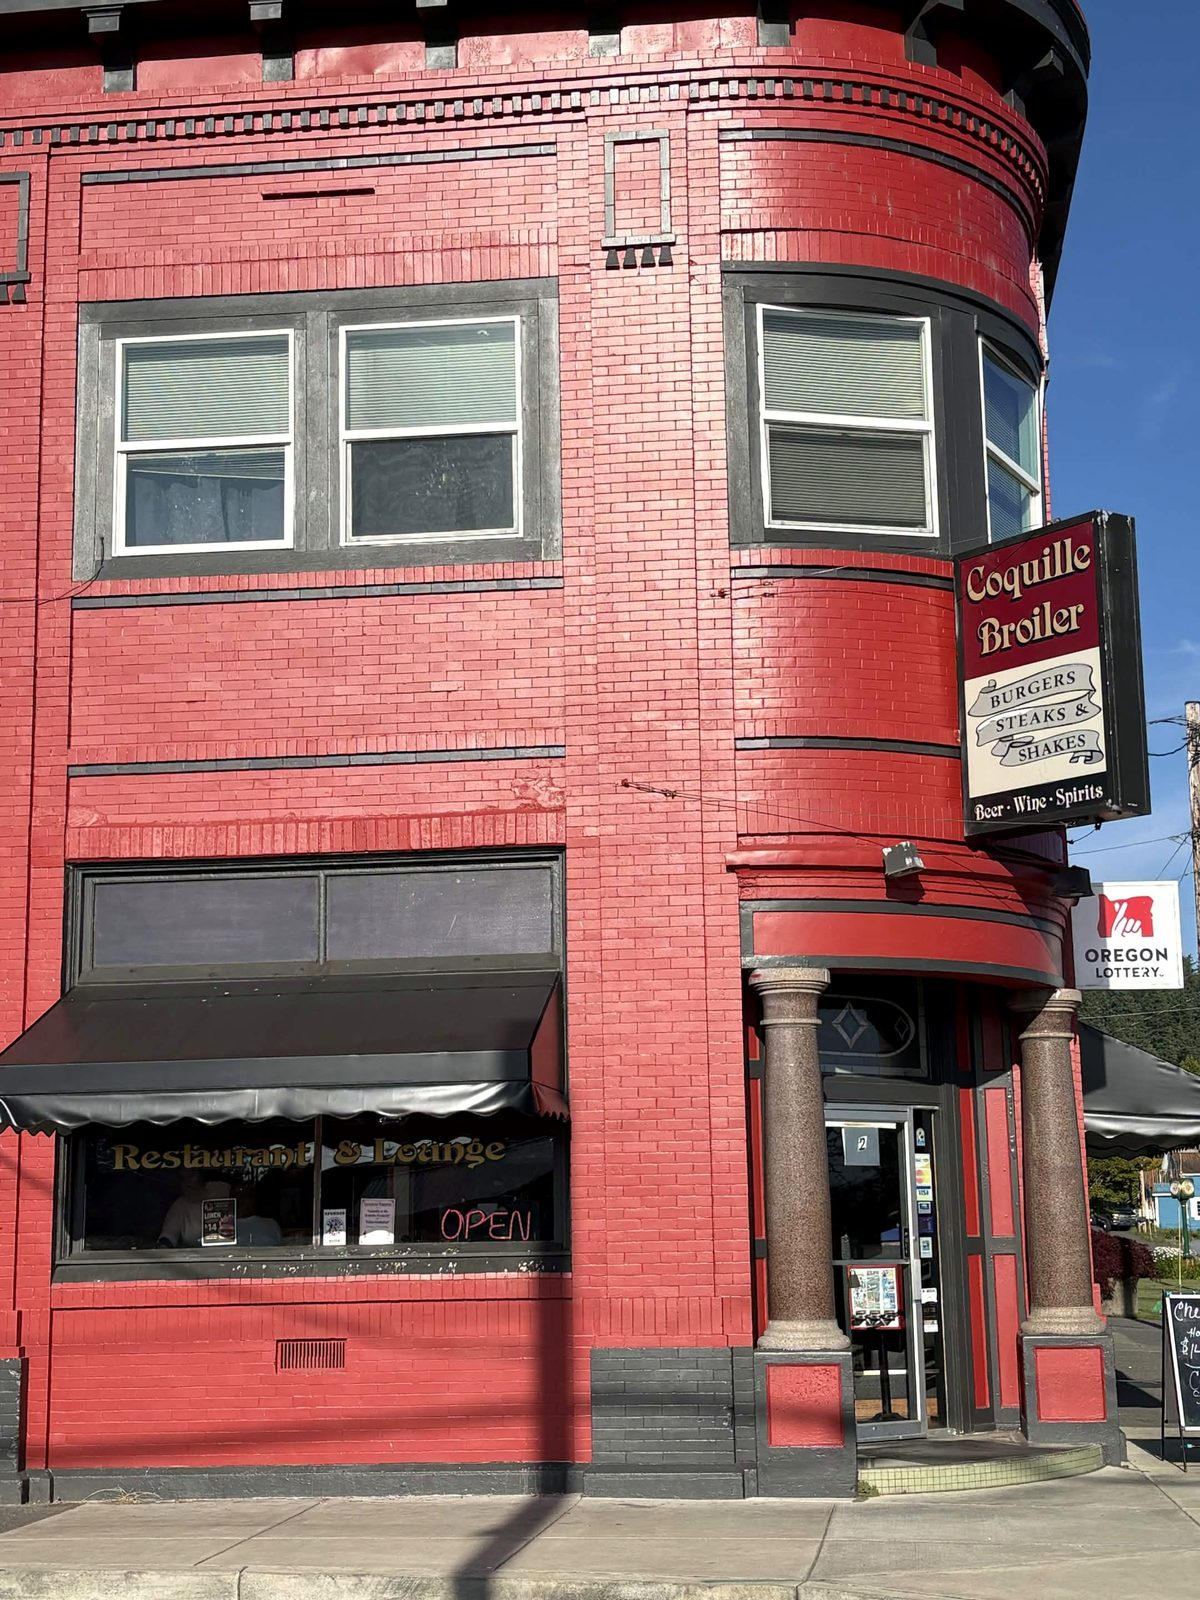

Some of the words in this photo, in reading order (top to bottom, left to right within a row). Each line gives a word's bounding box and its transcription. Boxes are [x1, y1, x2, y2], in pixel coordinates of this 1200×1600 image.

[967, 538, 1091, 602] Coquille
[978, 601, 1085, 656] Broiler
[990, 670, 1075, 709] BURGERS
[996, 707, 1066, 733] STEAKS
[1075, 703, 1089, 717] &
[1019, 734, 1086, 762] SHAKES
[974, 804, 1002, 821] Beer
[1013, 795, 1047, 815] Wine
[1056, 783, 1104, 809] Spirits
[1085, 948, 1168, 962] OREGON
[1096, 967, 1159, 978] LOTTERY
[112, 1141, 311, 1170] Restaurant
[334, 1140, 361, 1165] &
[373, 1138, 506, 1169] Lounge
[859, 1137, 866, 1151] 2
[441, 1208, 531, 1241] OPEN
